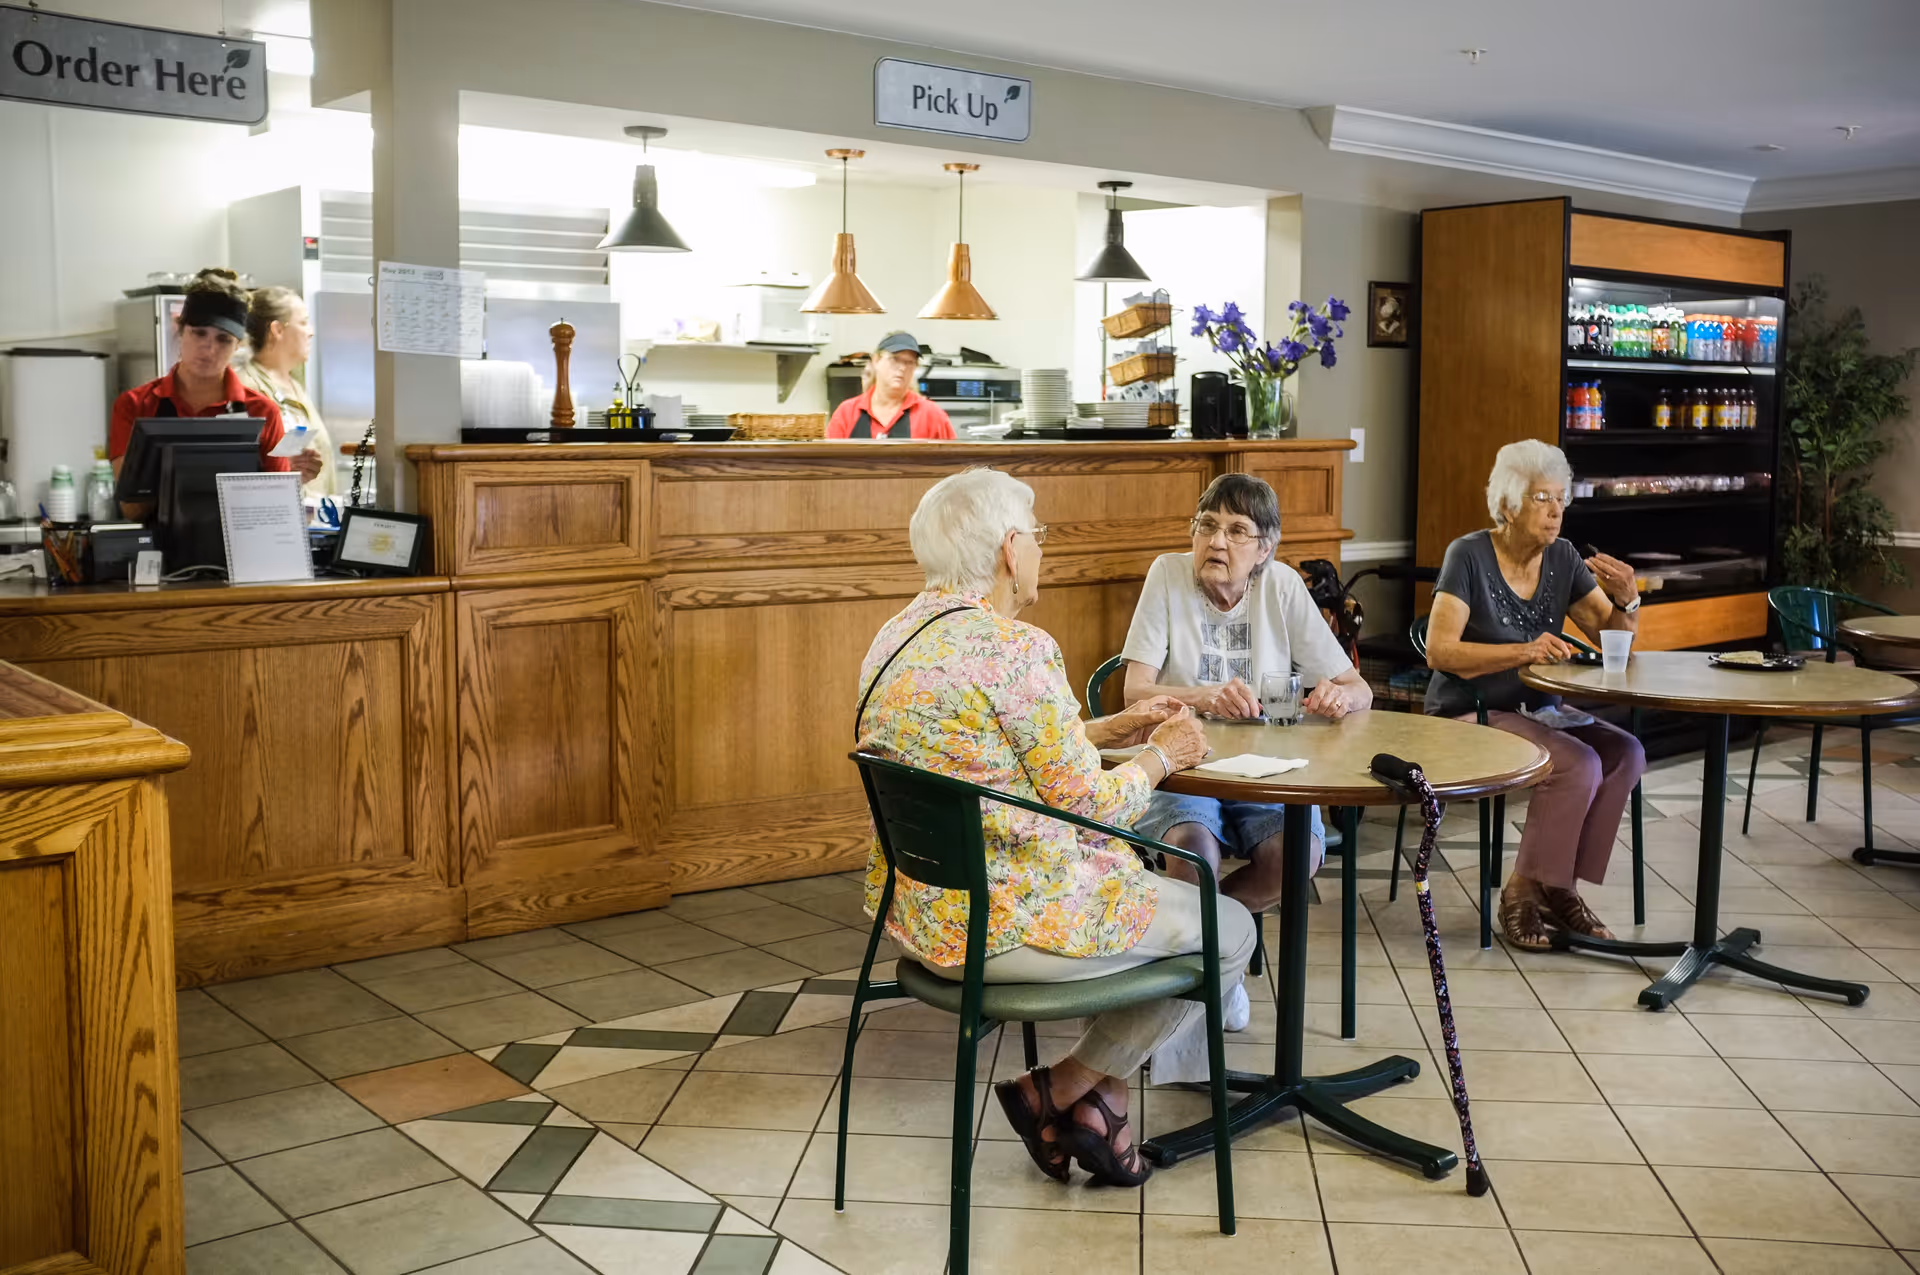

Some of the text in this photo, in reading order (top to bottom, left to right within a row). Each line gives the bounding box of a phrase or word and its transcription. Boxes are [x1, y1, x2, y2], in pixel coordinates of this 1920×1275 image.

[12, 40, 246, 100] Order Here
[913, 84, 998, 126] Pick Up
